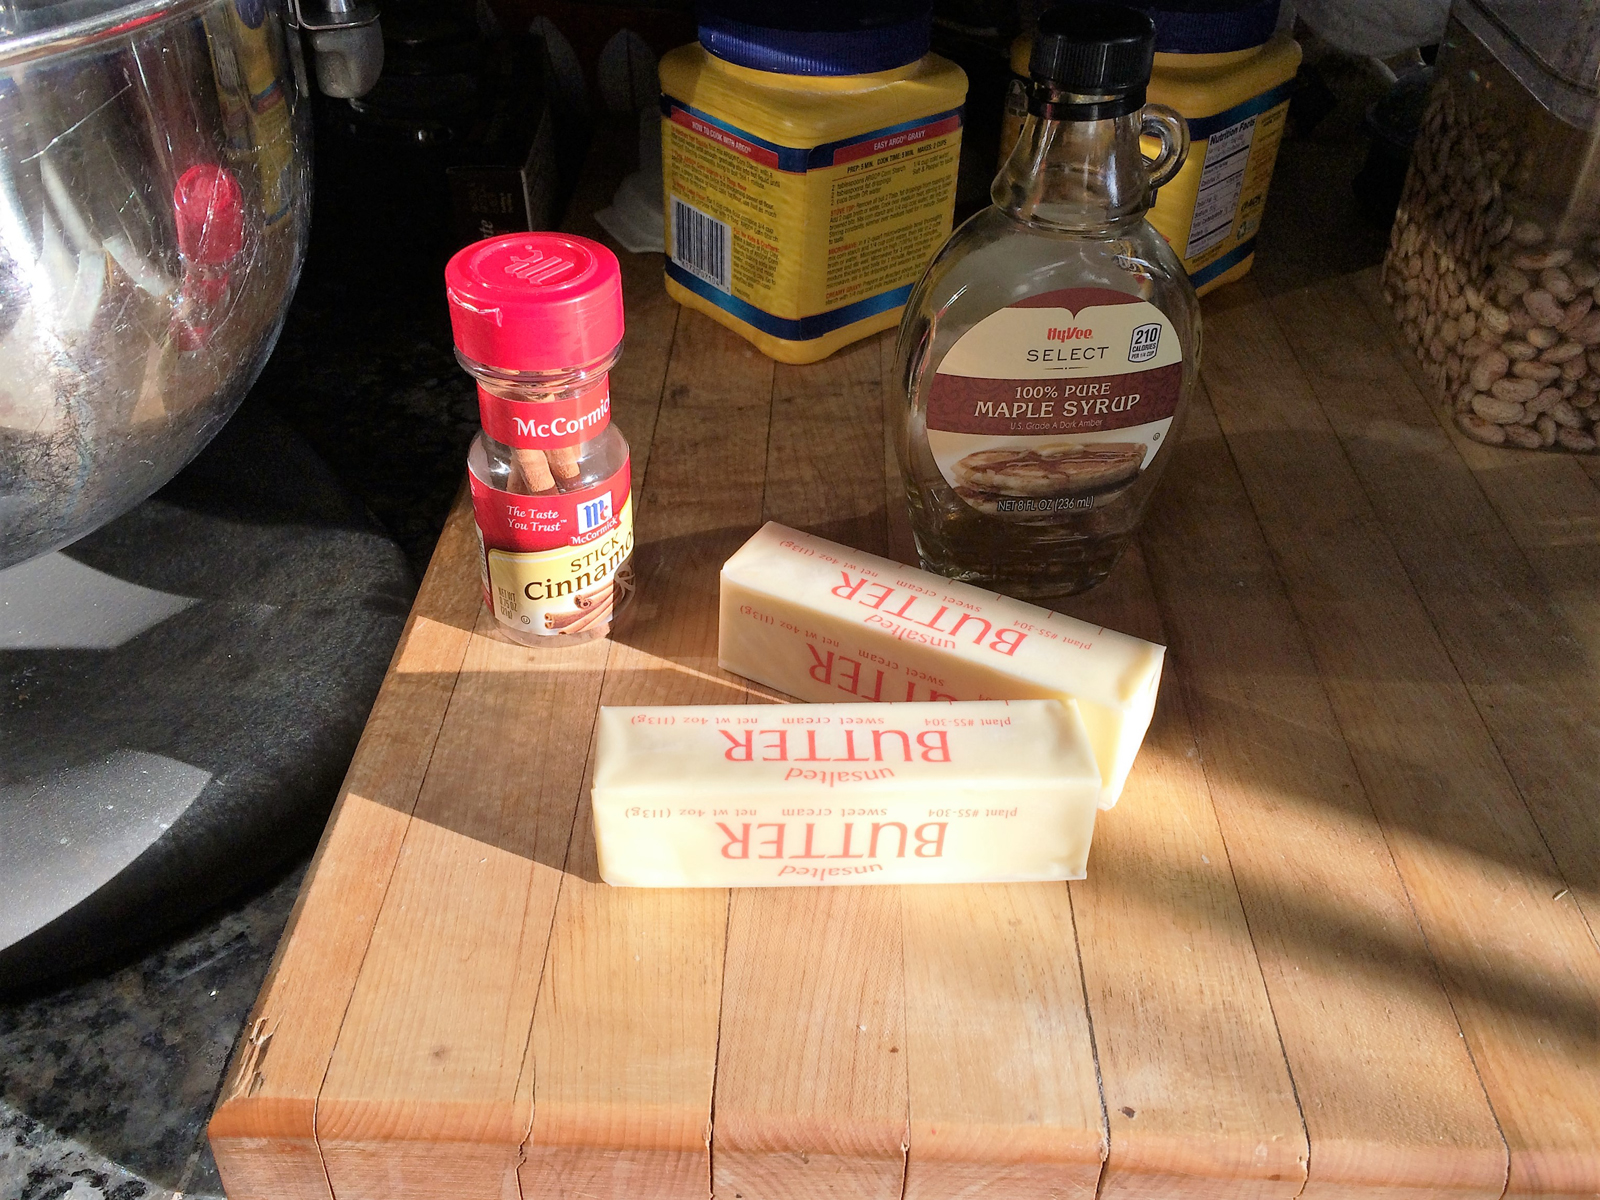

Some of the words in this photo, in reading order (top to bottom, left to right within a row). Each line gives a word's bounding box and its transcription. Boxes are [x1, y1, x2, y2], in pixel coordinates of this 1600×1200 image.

[874, 140, 888, 151] EASY
[908, 130, 926, 141] GRAVY
[1210, 127, 1238, 146] Nutrition
[1134, 328, 1158, 345] 210
[1026, 346, 1109, 362] SELECT
[1132, 343, 1156, 353] CALORIES
[1015, 385, 1058, 399] 100%
[1064, 382, 1112, 398] PURE
[974, 401, 1055, 418] MAPLE
[1062, 393, 1141, 417] SYRUP
[1010, 422, 1024, 430] U.S.
[1025, 422, 1050, 430] Grade
[1059, 420, 1077, 429] Dark
[1078, 419, 1103, 428] Amber
[997, 500, 1016, 512] NET
[1017, 500, 1024, 512] 8
[1025, 499, 1036, 511] FL
[1038, 499, 1053, 511] OZ
[1054, 497, 1075, 512] (236
[1076, 495, 1095, 510] mL)
[507, 505, 527, 518] The
[529, 509, 560, 519] Taste
[507, 518, 528, 531] You
[570, 518, 618, 545] McCormick
[570, 532, 620, 573] STICK
[779, 540, 815, 557] (113g)
[524, 531, 633, 601] Cinnamo
[819, 553, 839, 565] 4oz
[844, 561, 856, 570] wt
[860, 568, 878, 578] net
[896, 579, 937, 598] cream
[942, 595, 982, 613] sweet
[739, 605, 774, 625] (113g)
[831, 570, 1028, 657] BUTTER
[780, 619, 800, 635] 4oz
[805, 630, 818, 639] wt
[864, 613, 956, 650] unsalted
[1012, 619, 1058, 640] #55-304
[822, 637, 839, 648] net
[1062, 636, 1093, 651] plant
[858, 649, 899, 671] cream
[906, 666, 945, 687] sweet
[631, 714, 676, 725] (113g)
[683, 717, 709, 725] 4oz
[737, 717, 758, 725] net
[782, 717, 831, 725] cream
[840, 717, 885, 725] sweet
[924, 718, 974, 727] #55-304
[981, 716, 1012, 727] plant
[718, 729, 951, 762] BUTTER
[784, 767, 895, 788] unsalted
[625, 807, 671, 819] (113g)
[679, 808, 705, 818] 4oz
[736, 808, 757, 816] net
[782, 808, 832, 816] cream
[841, 808, 887, 817] sweet
[928, 808, 978, 818] #55-304
[985, 807, 1018, 819] plant
[715, 821, 949, 859] BUTTER
[778, 863, 883, 881] unsalted
